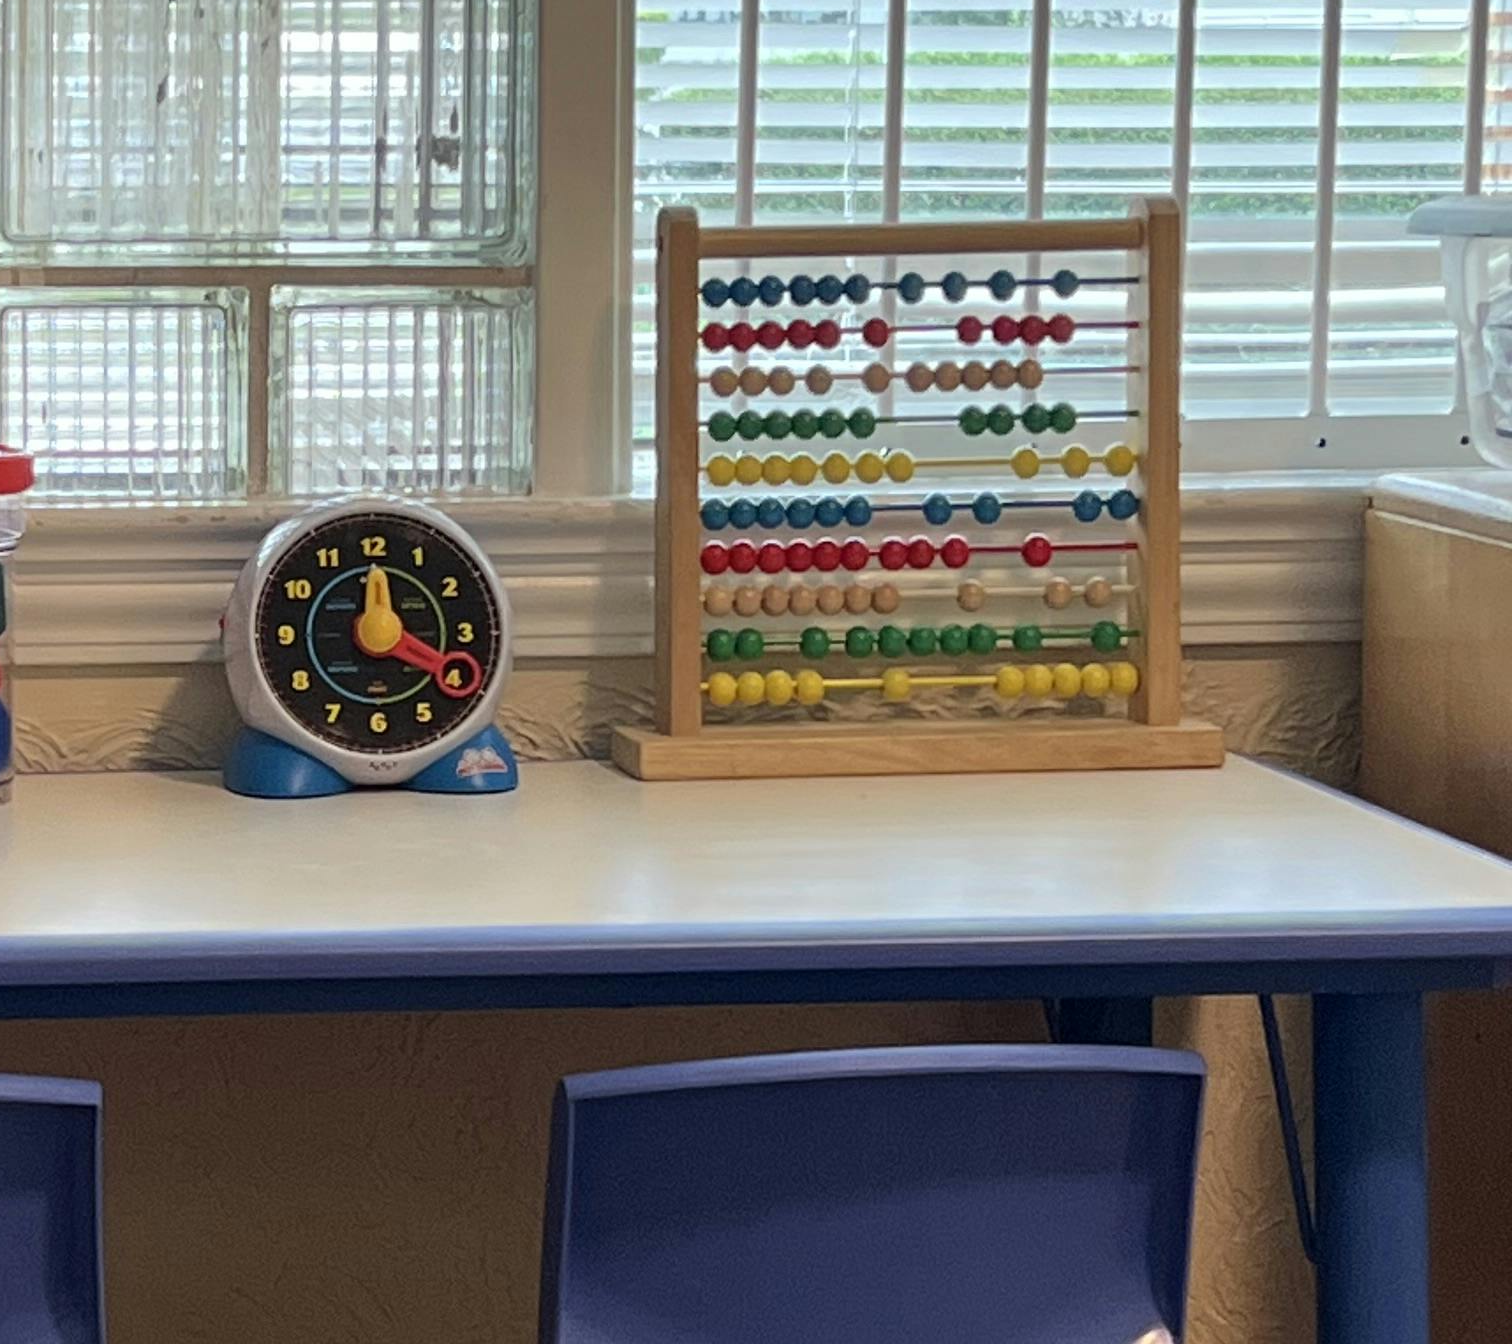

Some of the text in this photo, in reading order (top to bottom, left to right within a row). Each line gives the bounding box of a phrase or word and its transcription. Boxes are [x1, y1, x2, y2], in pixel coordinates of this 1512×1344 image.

[316, 547, 339, 567] 11
[360, 536, 387, 557] 12
[411, 546, 424, 566] 1
[284, 579, 312, 599] 10
[441, 576, 459, 597] 2
[277, 625, 295, 645] 9
[457, 622, 474, 643] 3
[291, 670, 310, 691] 8
[444, 668, 463, 688] 4
[324, 703, 341, 724] 7
[369, 712, 388, 733] 6
[415, 702, 433, 723] 5
